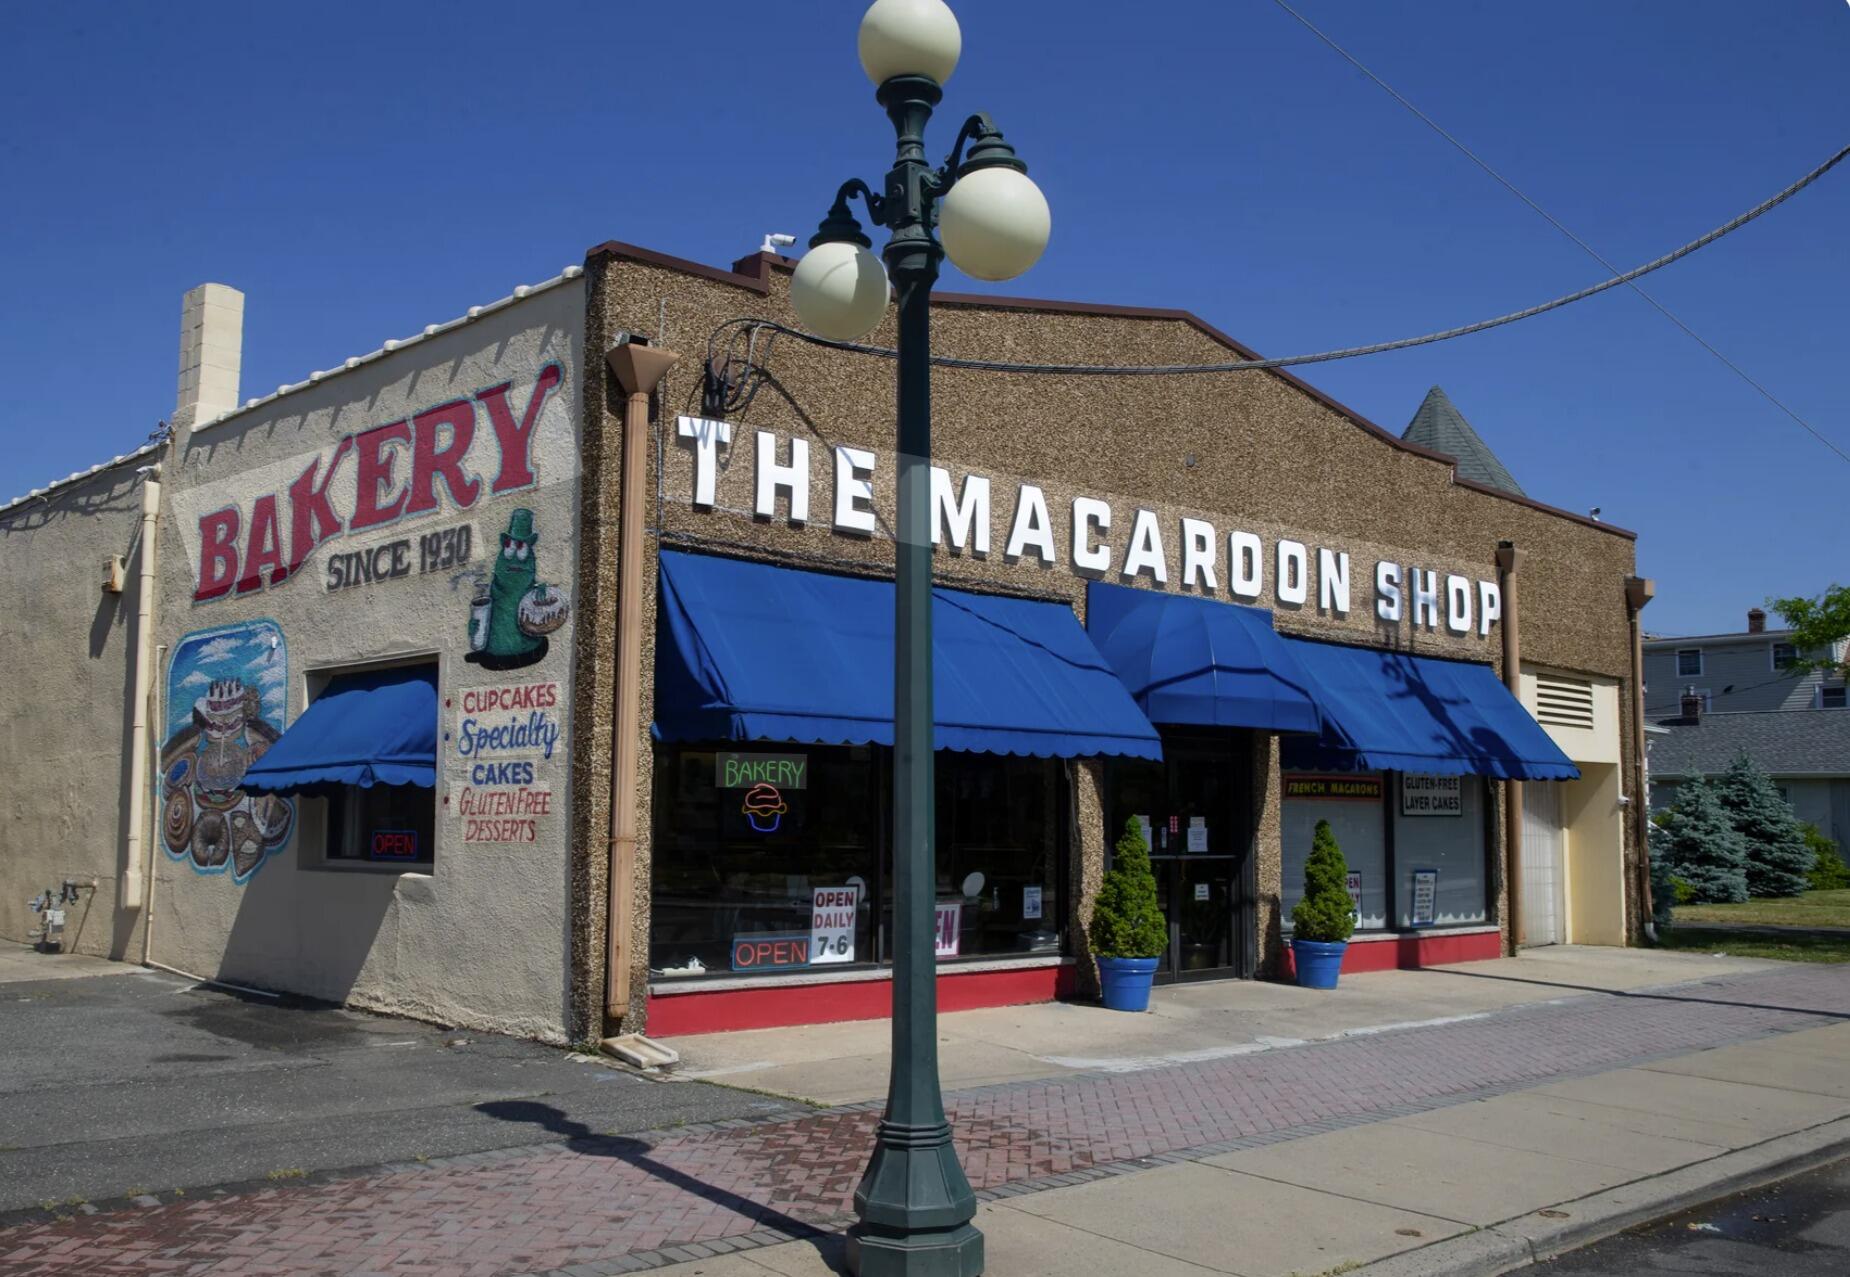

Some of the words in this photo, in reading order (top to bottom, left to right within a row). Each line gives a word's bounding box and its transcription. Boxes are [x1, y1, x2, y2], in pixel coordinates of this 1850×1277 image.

[193, 361, 565, 604] BAKERY
[678, 415, 876, 532] THE
[930, 466, 1350, 612] MACAROON
[1376, 560, 1500, 635] SHOP
[327, 539, 411, 591] SINCE
[420, 523, 472, 574] 1930
[464, 684, 557, 713] CUPCAKES
[459, 711, 559, 759] Specialty
[472, 762, 534, 785] CAKES
[726, 760, 804, 788] BAKERY
[1405, 777, 1458, 790] GLUTEN-FREE
[1288, 782, 1325, 793] FRENCH
[1405, 796, 1429, 810] LAYER
[1433, 796, 1459, 810] CAKES
[465, 820, 536, 842] DESSERTS
[375, 834, 414, 854] OPEN
[815, 892, 854, 908] OPEN
[814, 912, 854, 929] DAILY
[736, 942, 806, 966] OPEN
